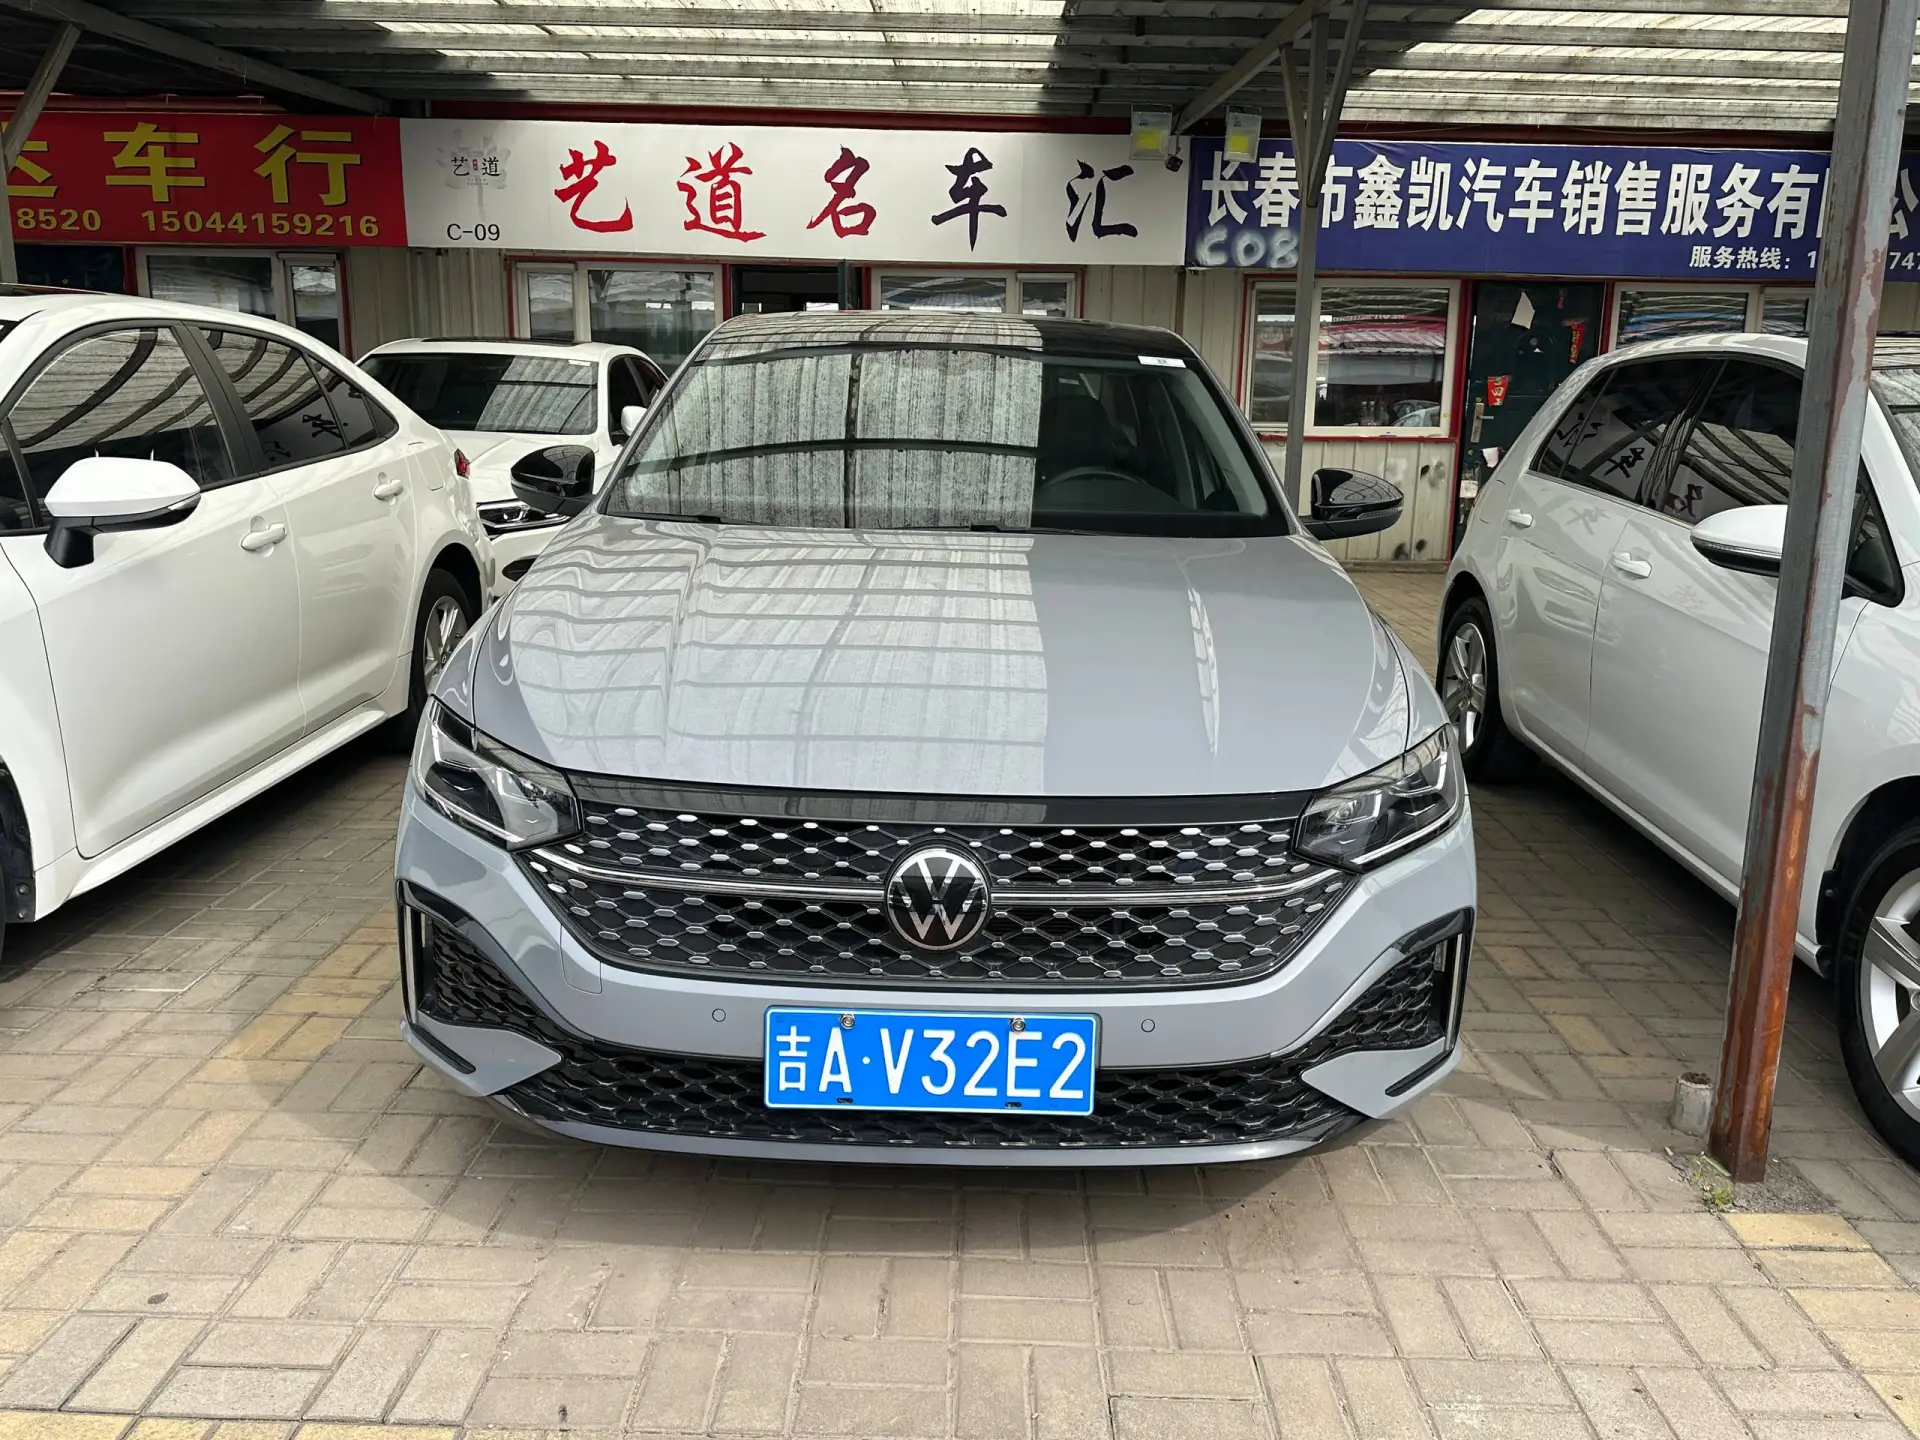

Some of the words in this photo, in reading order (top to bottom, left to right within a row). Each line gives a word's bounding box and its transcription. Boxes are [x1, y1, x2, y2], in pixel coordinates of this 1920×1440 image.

[554, 139, 1139, 252] 艺道名车汇
[142, 210, 380, 237] 15044159216
[446, 223, 500, 241] C-09
[775, 1024, 1086, 1100] 吉A·V32E2
